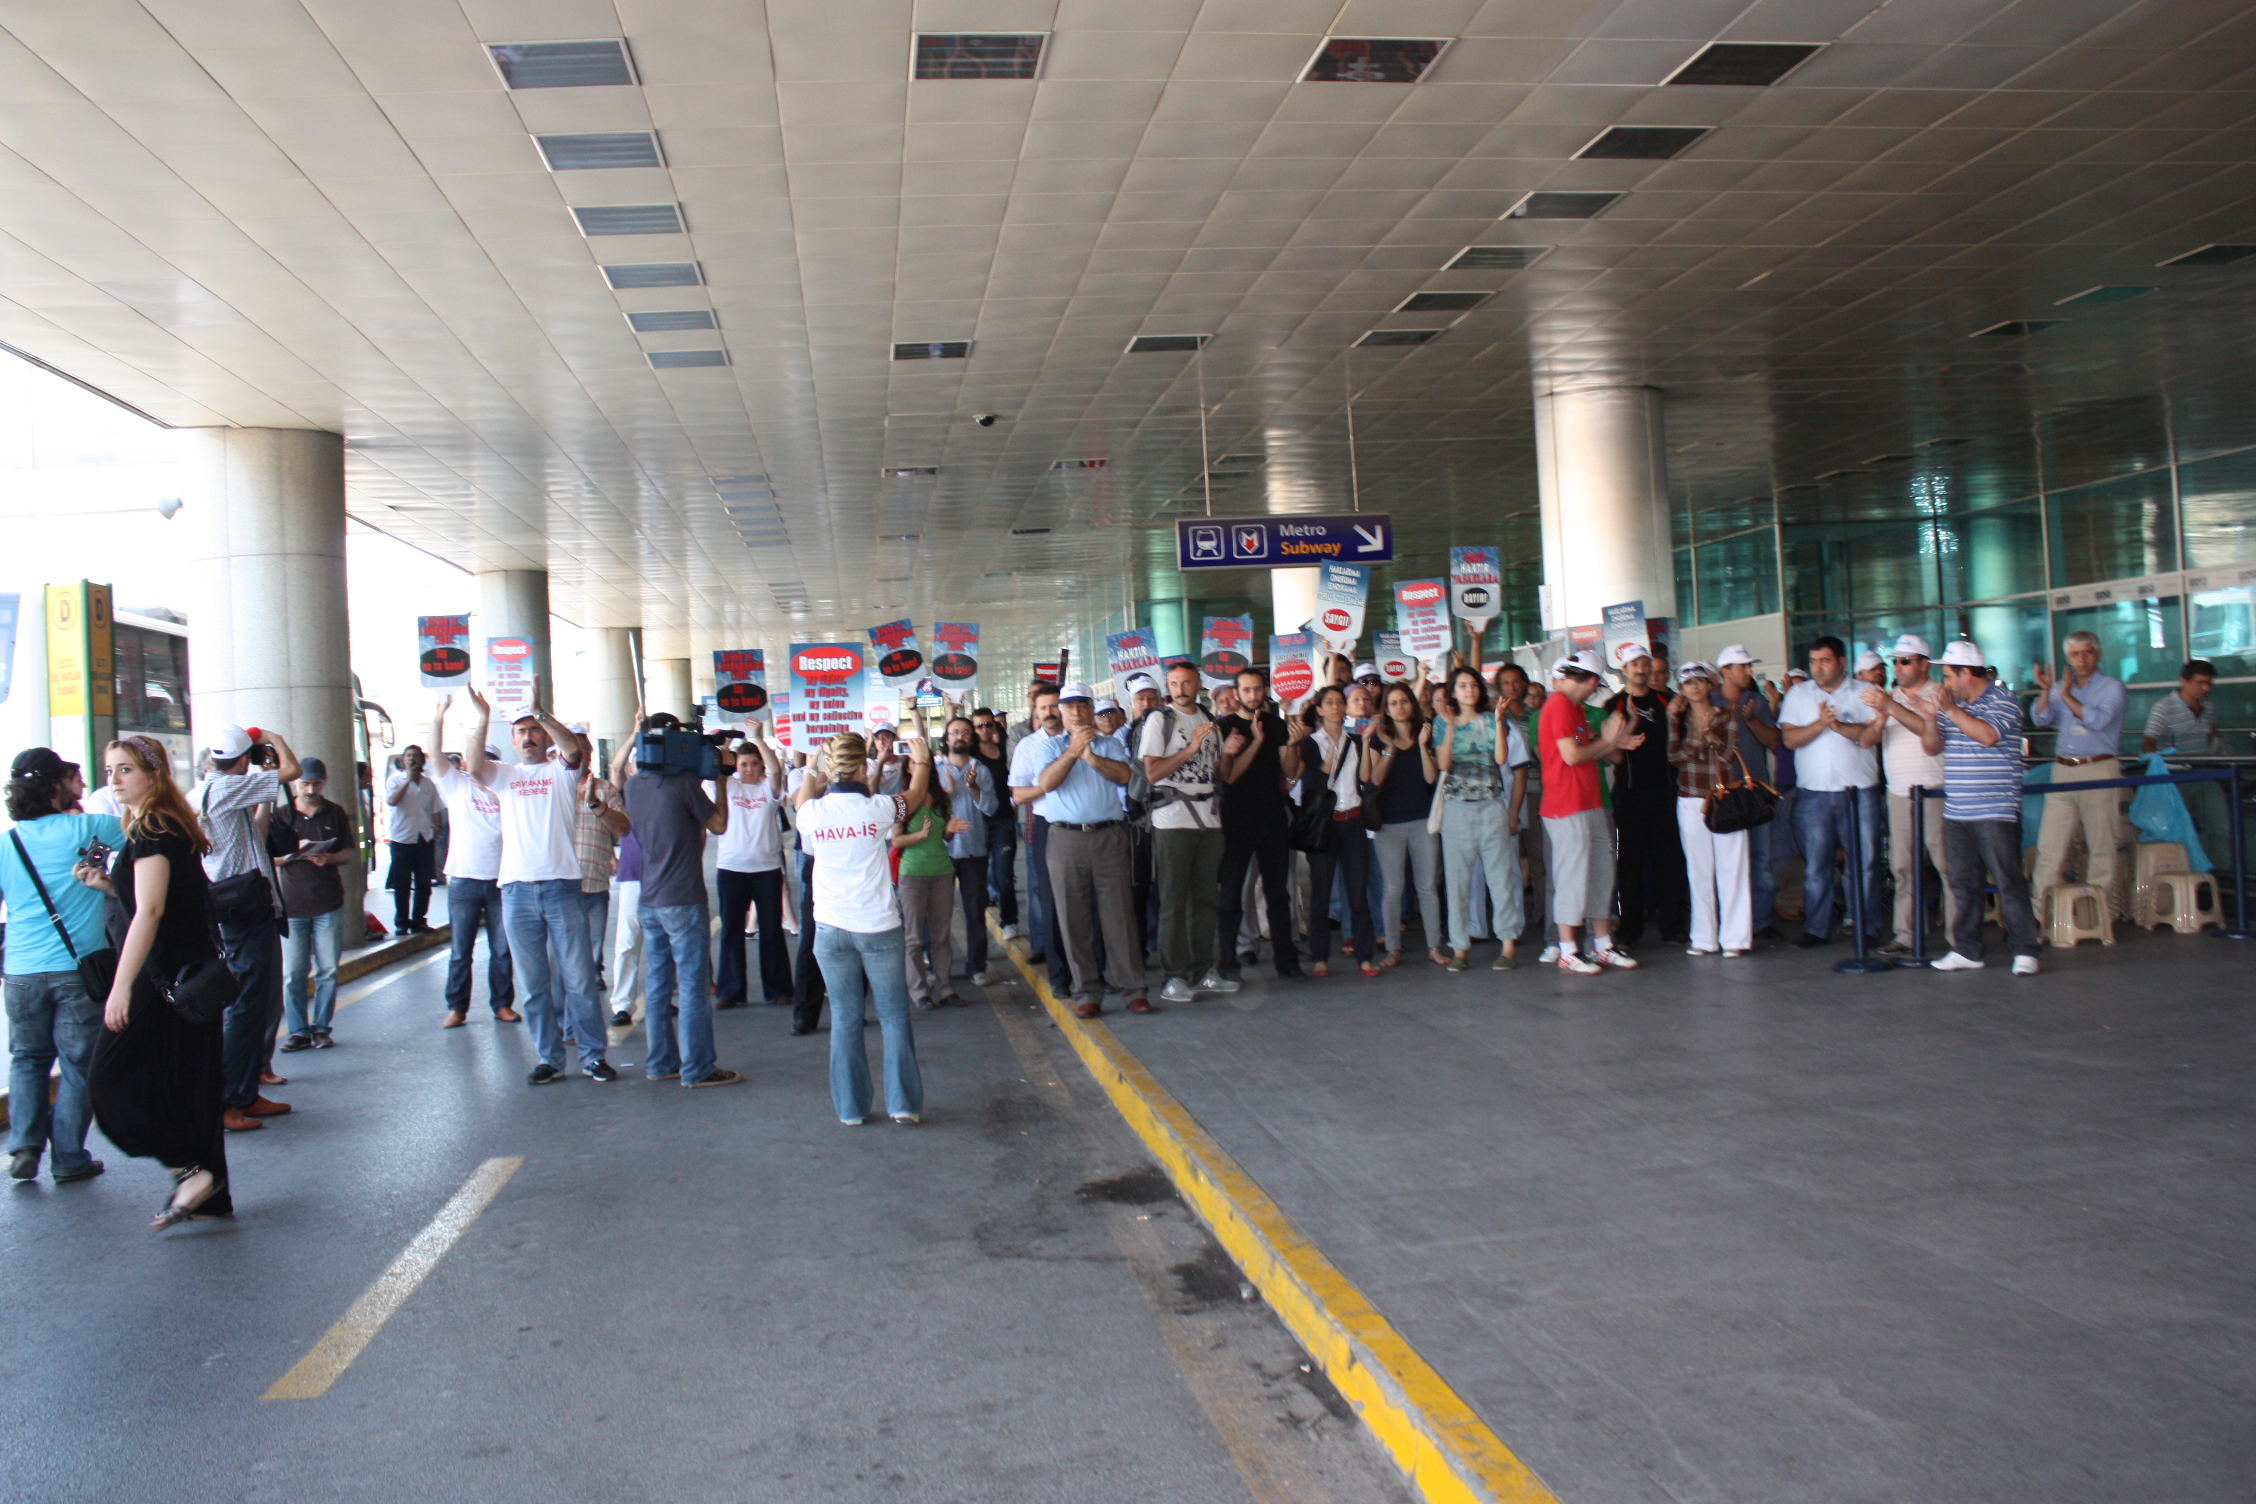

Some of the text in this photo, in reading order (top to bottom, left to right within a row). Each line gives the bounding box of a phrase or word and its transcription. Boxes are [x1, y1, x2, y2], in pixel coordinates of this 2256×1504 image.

[1279, 523, 1327, 537] Metro
[1280, 540, 1342, 557] Subway
[60, 599, 70, 622] D
[798, 656, 853, 672] Respect
[804, 688, 816, 698] my
[809, 699, 845, 709] my union
[792, 710, 863, 722] and my collective
[806, 723, 850, 734] bargaining
[815, 821, 878, 841] HAVA-İŞ
